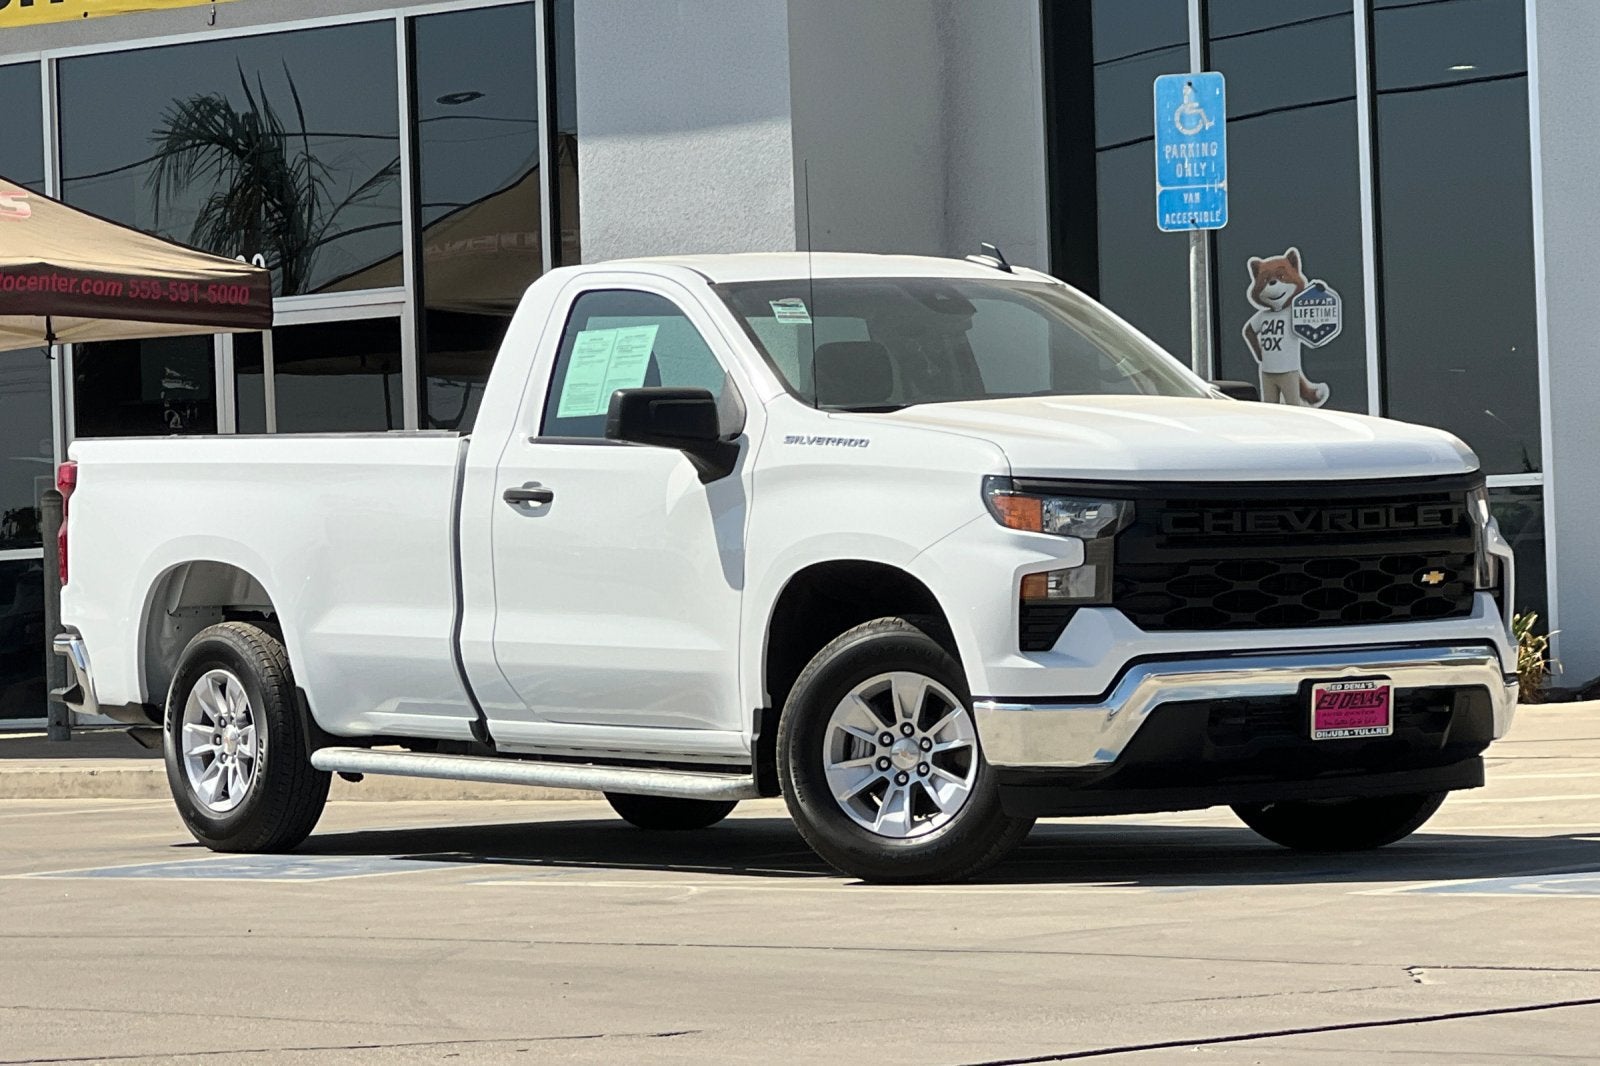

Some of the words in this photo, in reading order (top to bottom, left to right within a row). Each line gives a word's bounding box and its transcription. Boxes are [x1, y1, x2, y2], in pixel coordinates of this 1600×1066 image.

[1164, 142, 1218, 159] PARKING
[1176, 163, 1207, 178] ONLY
[1183, 192, 1201, 204] VAN
[1165, 211, 1221, 225] ACCESSIBLE
[128, 279, 250, 305] 559-591-5000
[1294, 306, 1337, 319] LIFETIME
[1261, 320, 1285, 335] CAR
[784, 435, 870, 448] SILVERADO
[1161, 503, 1466, 536] CHEVROLET
